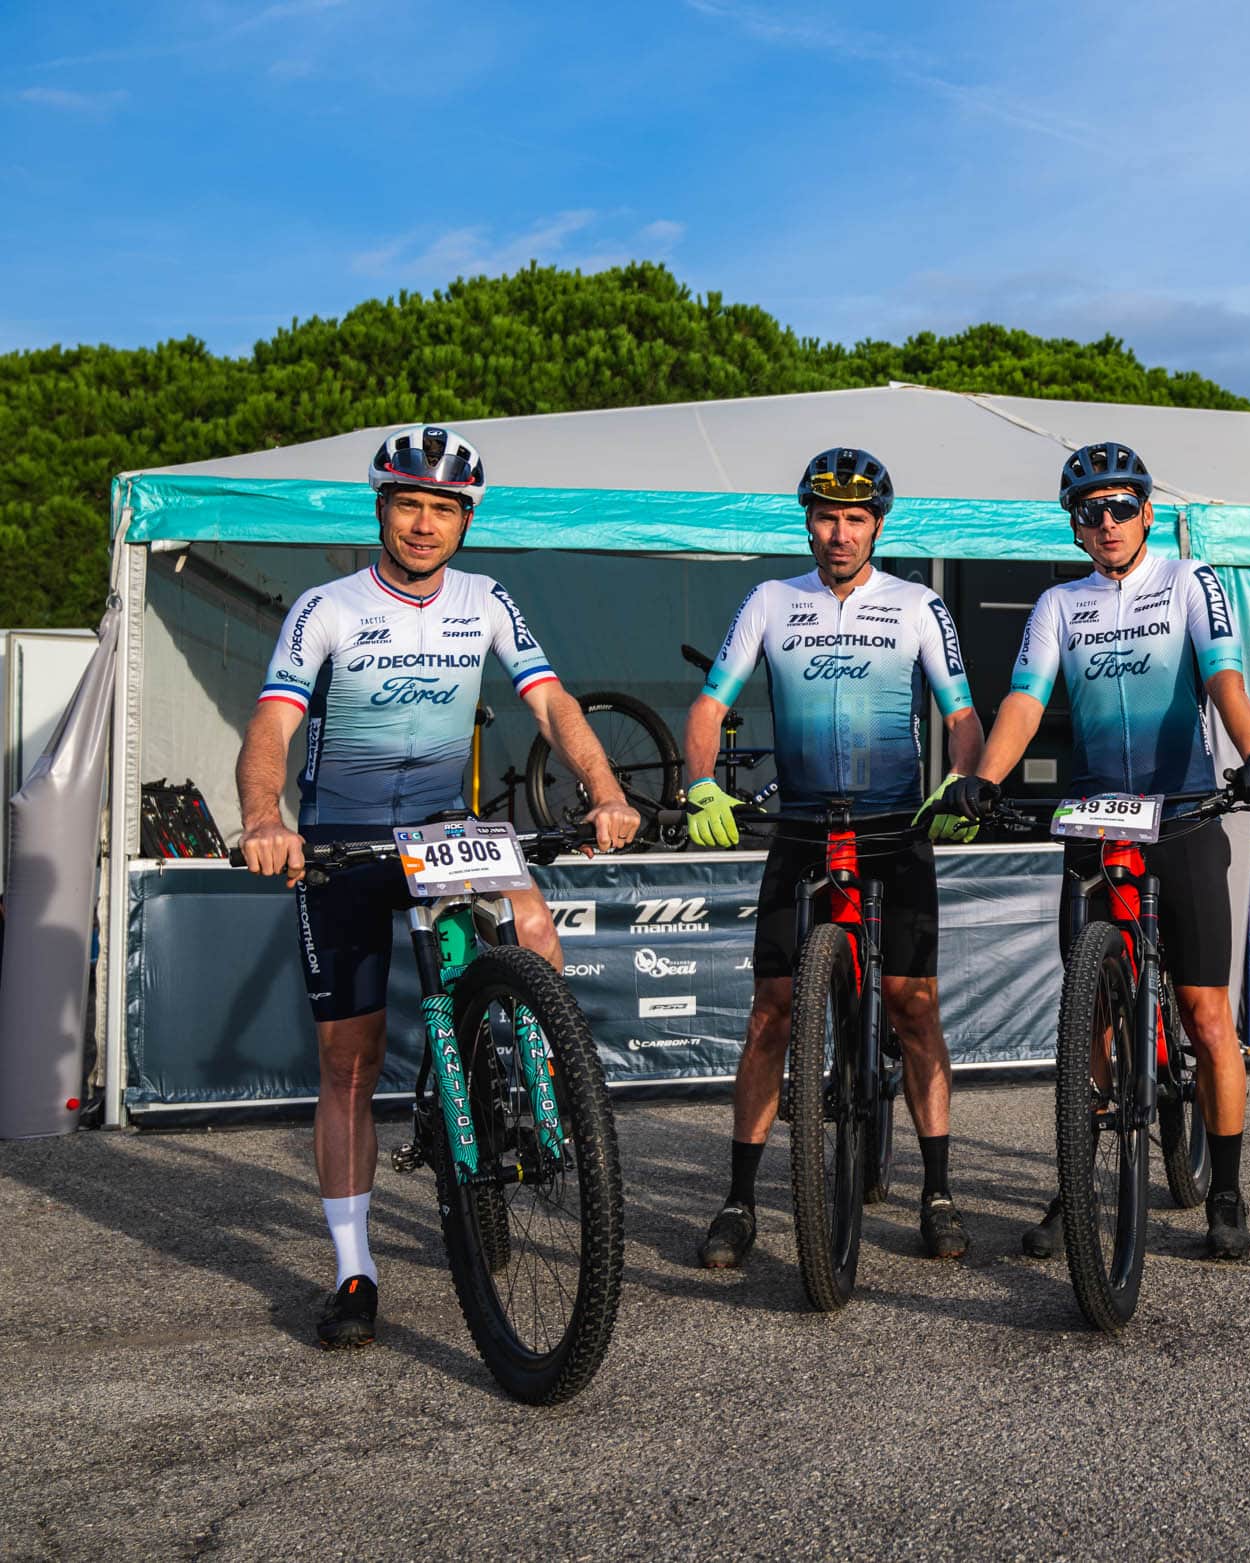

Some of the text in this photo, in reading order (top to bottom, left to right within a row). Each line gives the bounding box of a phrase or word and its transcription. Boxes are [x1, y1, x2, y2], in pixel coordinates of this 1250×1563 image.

[1200, 572, 1229, 635] MAVIC
[293, 595, 323, 652] DECATHLON
[360, 616, 386, 625] TACTIC
[441, 617, 480, 625] TRP
[495, 590, 533, 646] MAVIC
[856, 614, 900, 624] SRAM
[804, 634, 896, 649] DECATHLON
[933, 604, 962, 672] MAVIC
[1084, 621, 1171, 646] DECATHLON
[377, 653, 480, 670] DECATHLON
[803, 654, 871, 681] Ford
[1085, 649, 1151, 680] Ford
[370, 676, 459, 706] Ford
[1075, 800, 1100, 814] 49
[1104, 800, 1142, 815] 369
[399, 832, 424, 841] CIC
[425, 843, 454, 867] 48
[458, 840, 501, 862] 906
[300, 894, 321, 974] DECATHLON
[630, 922, 709, 935] manitou
[649, 957, 697, 978] Seal
[522, 1014, 559, 1128] MANITOU
[438, 1028, 474, 1146] MANITOU
